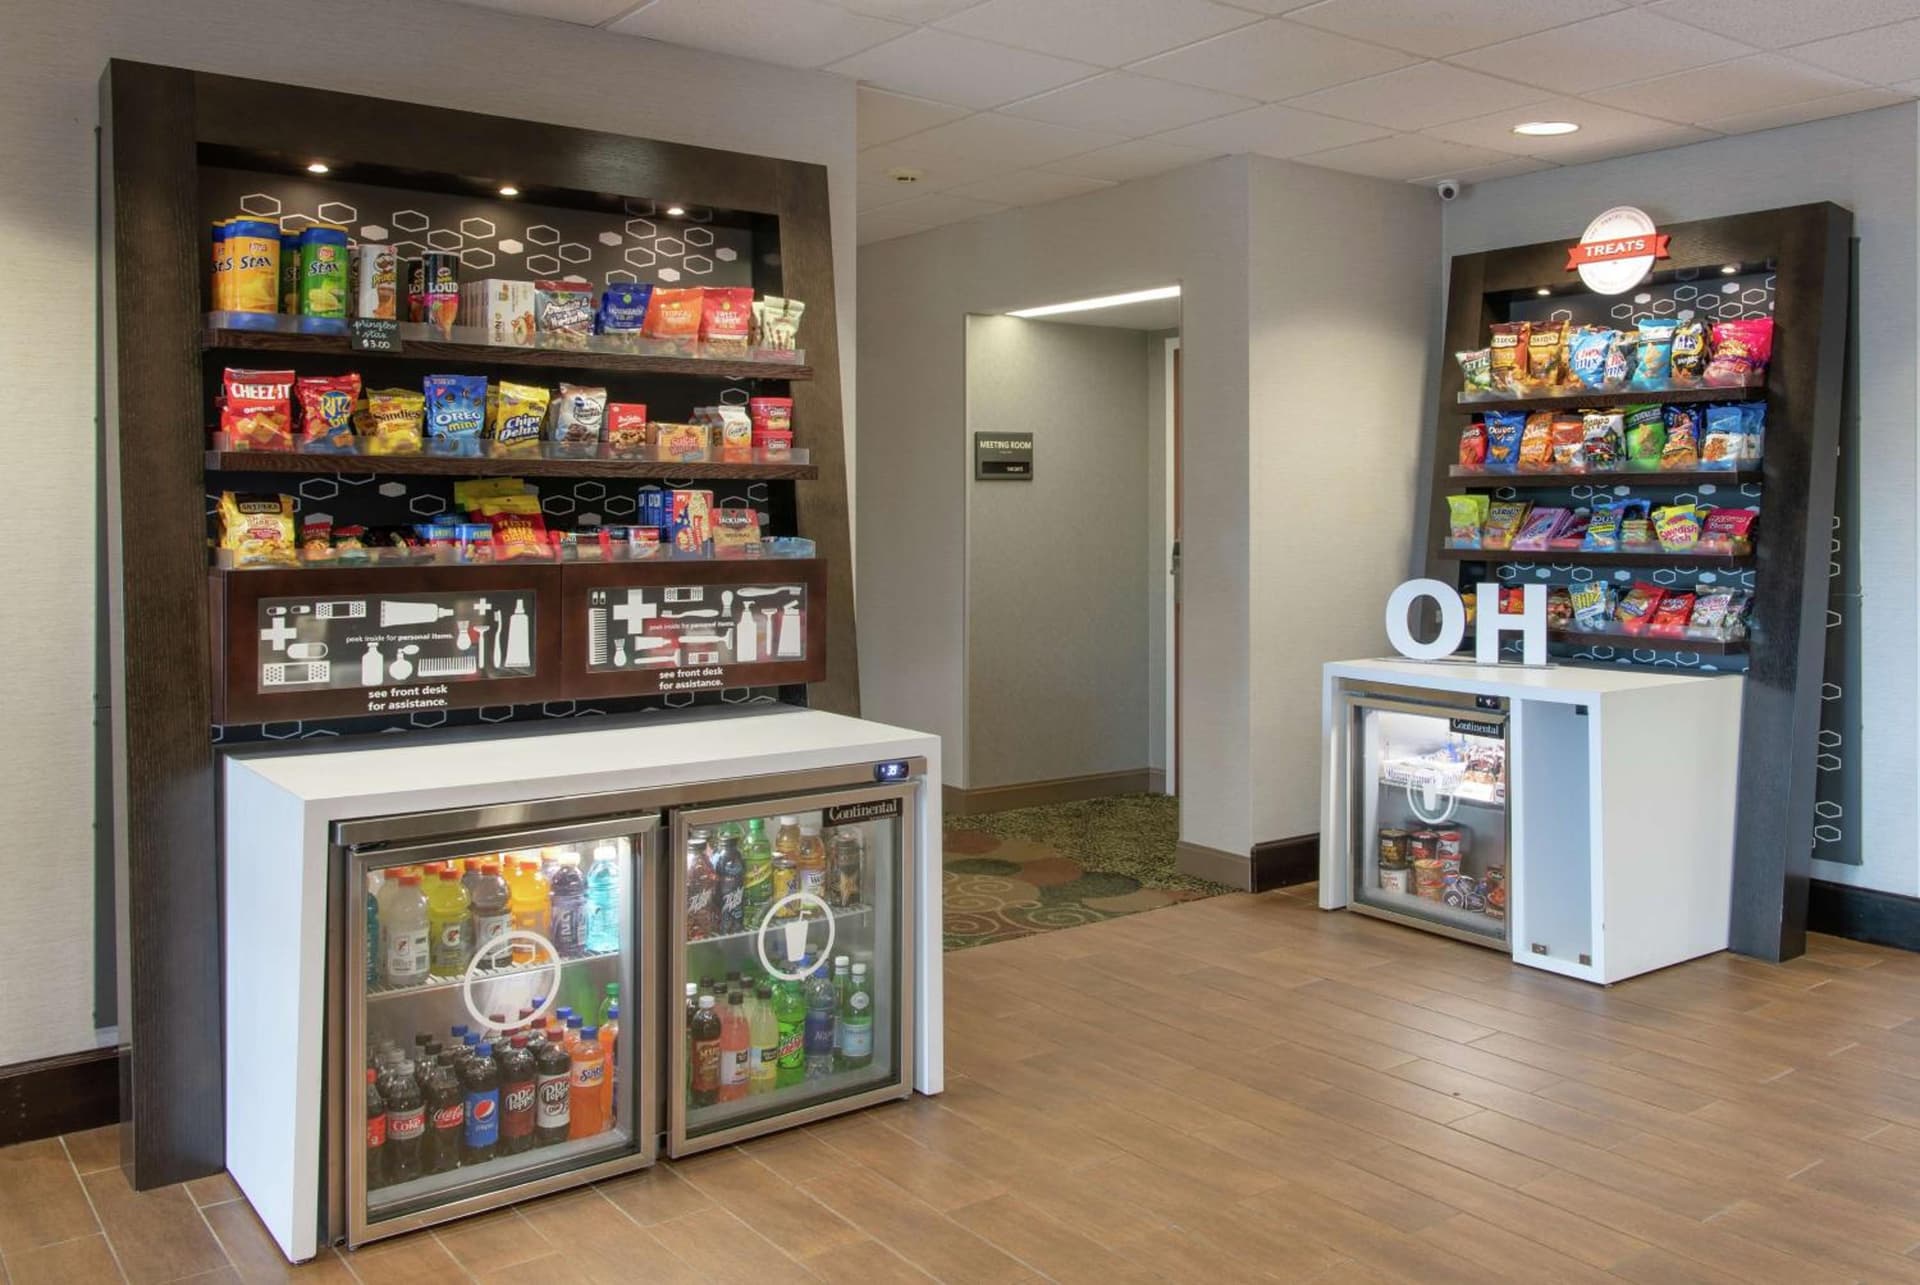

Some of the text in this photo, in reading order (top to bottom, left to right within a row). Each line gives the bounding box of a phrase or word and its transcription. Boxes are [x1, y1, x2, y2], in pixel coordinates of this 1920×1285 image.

[1585, 240, 1645, 256] TREATS
[429, 282, 458, 293] LOUD
[435, 411, 481, 426] OREO
[979, 440, 1032, 449] MEETING ROOM
[1386, 578, 1547, 665] OH
[398, 632, 431, 642] personal
[659, 666, 723, 679] see front desk
[369, 684, 448, 699] see front desk
[659, 681, 674, 690] for
[369, 698, 448, 711] for assistance.
[828, 800, 897, 821] Continental
